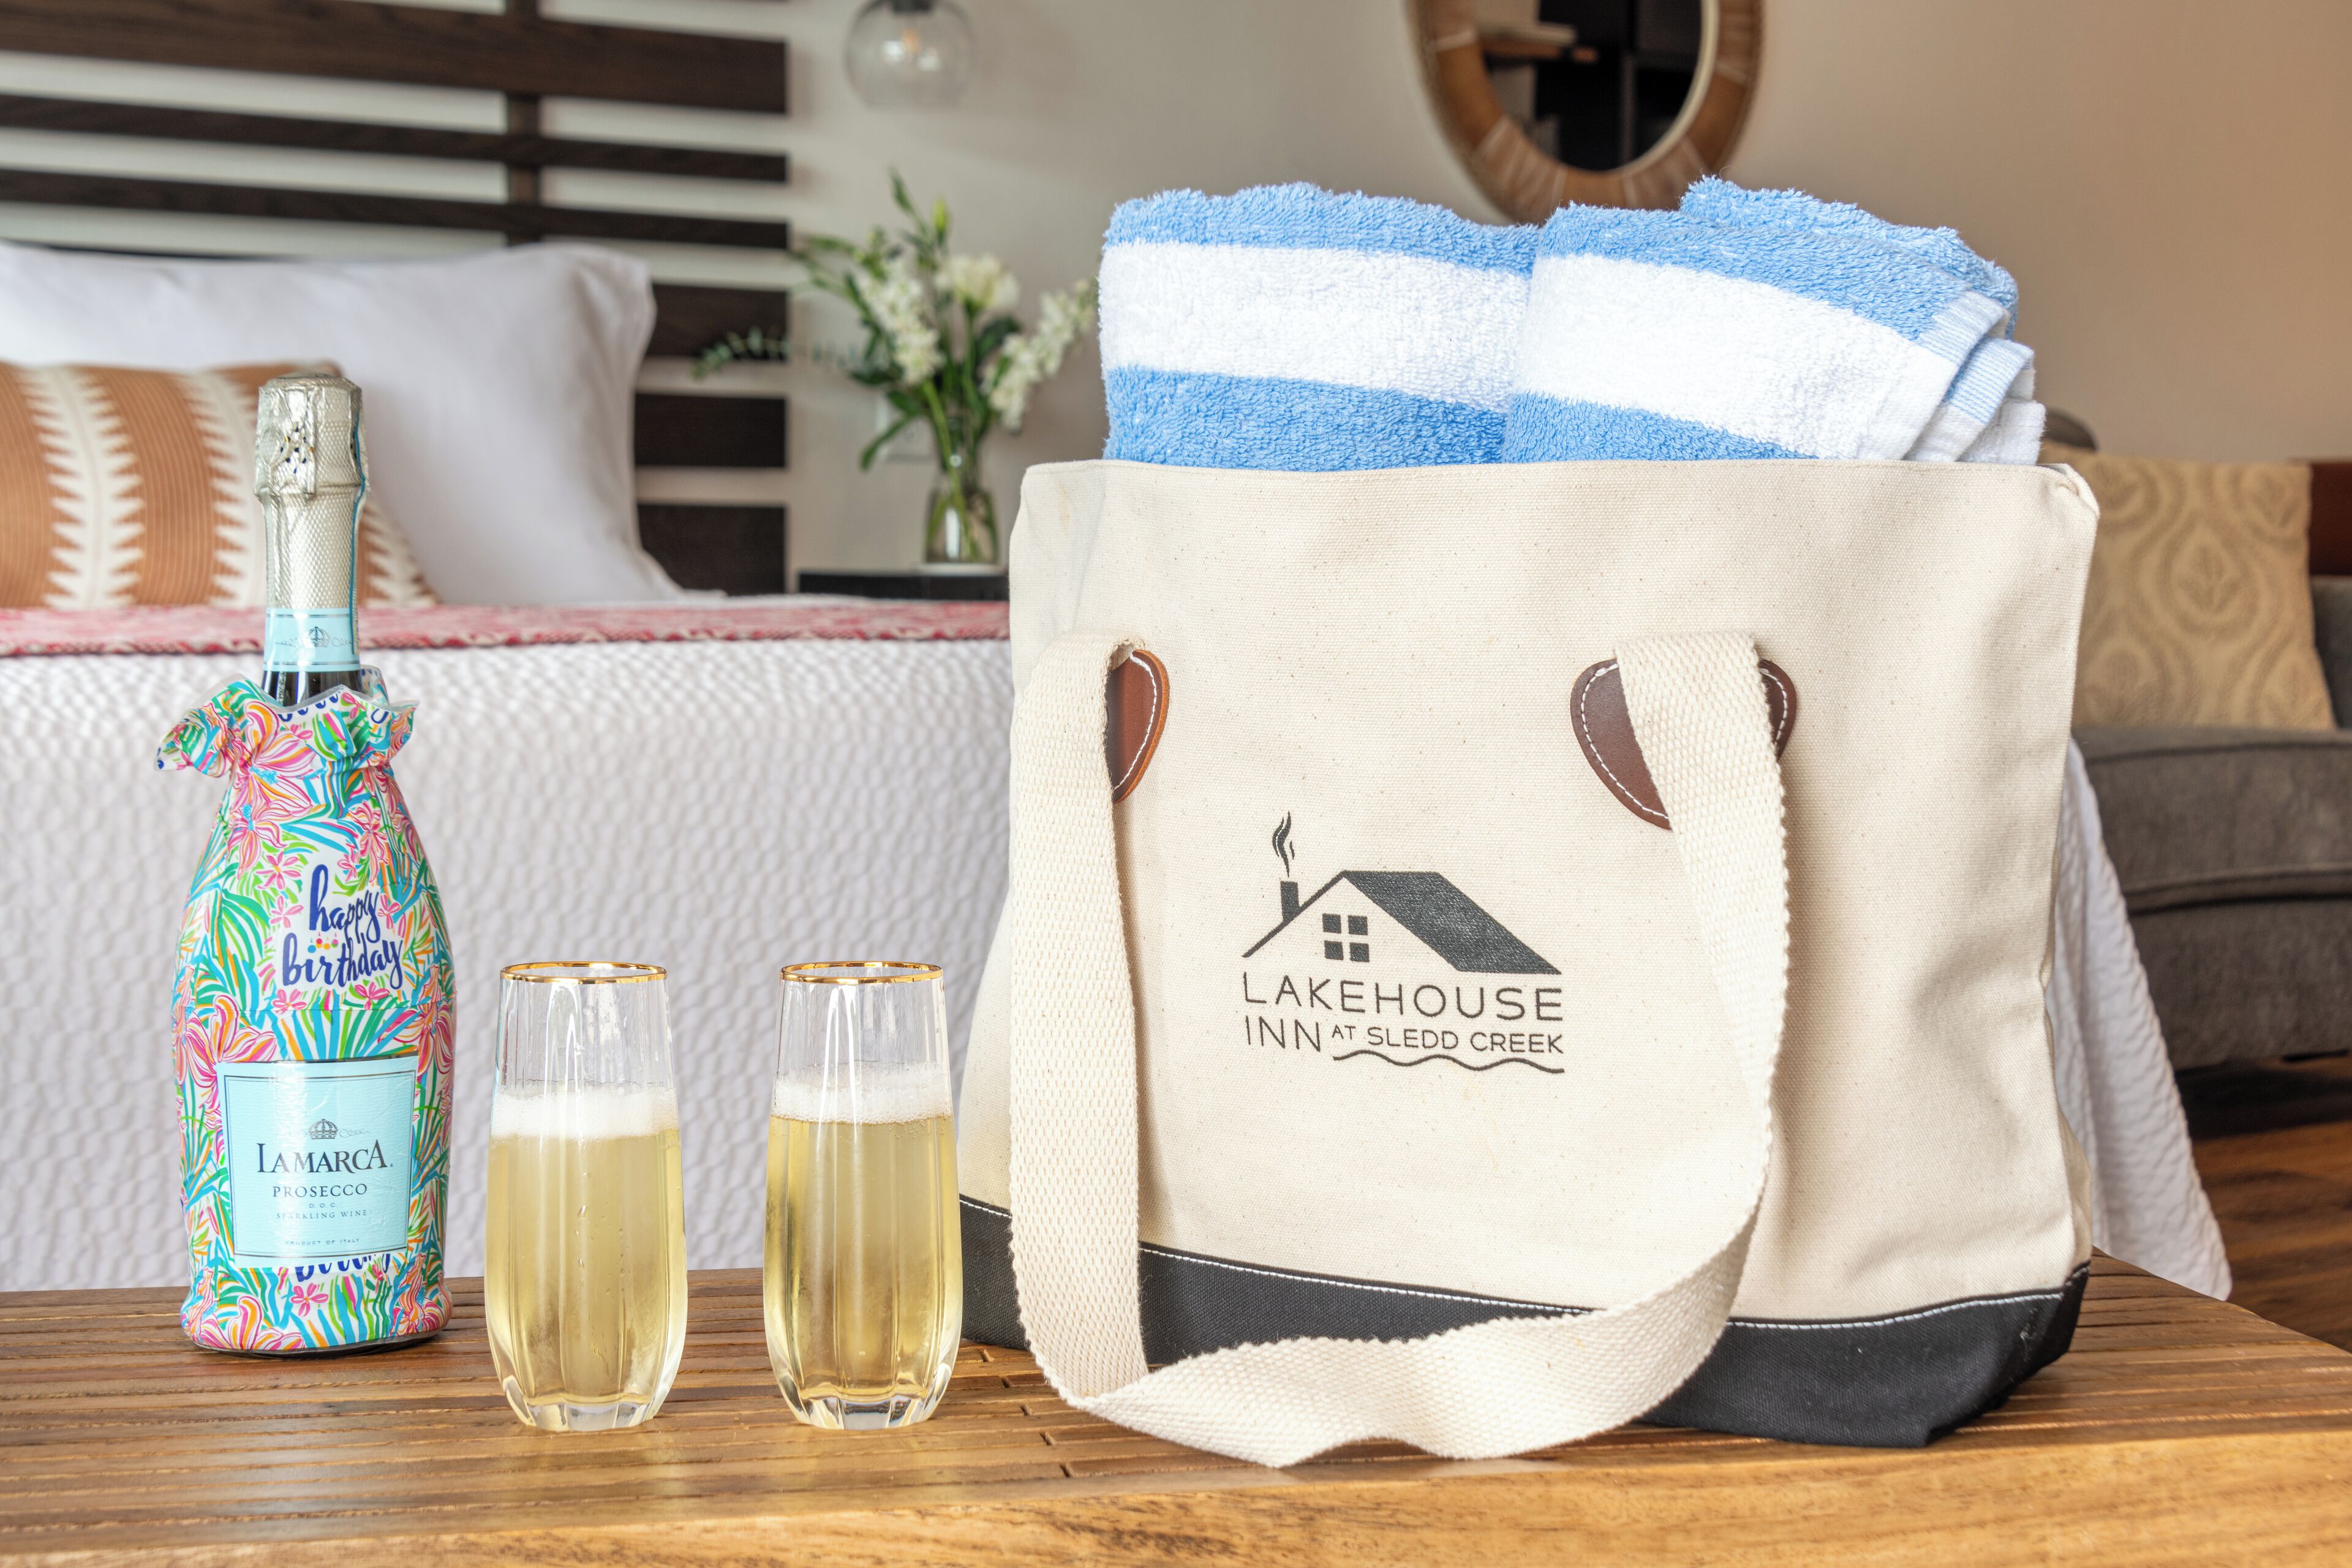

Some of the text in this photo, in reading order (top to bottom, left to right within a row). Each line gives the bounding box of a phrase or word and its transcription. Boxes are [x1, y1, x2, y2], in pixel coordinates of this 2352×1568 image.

[309, 864, 381, 944] happy
[282, 932, 403, 990] birthday
[1243, 972, 1563, 1021] LAKEHOUSE
[1245, 1016, 1564, 1054] INN AT SLEDD CREEK
[272, 1183, 368, 1198] PROSECCO
